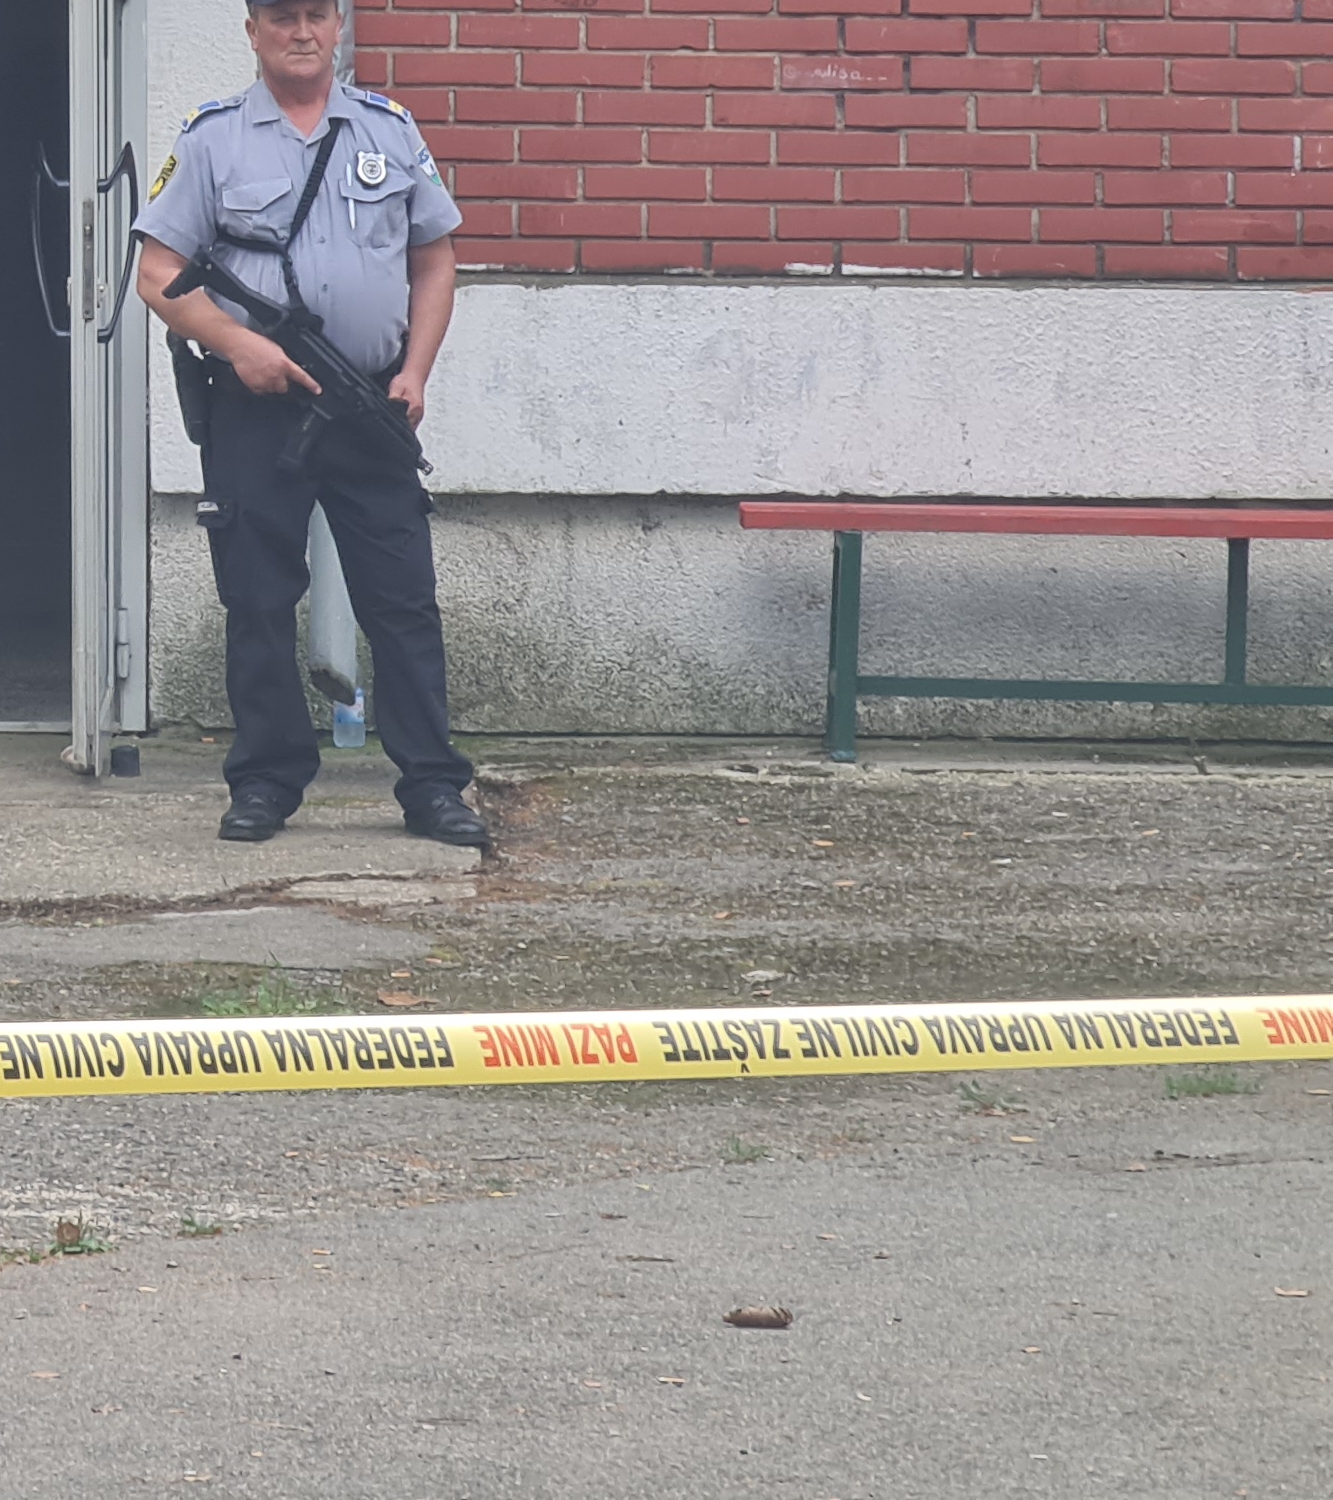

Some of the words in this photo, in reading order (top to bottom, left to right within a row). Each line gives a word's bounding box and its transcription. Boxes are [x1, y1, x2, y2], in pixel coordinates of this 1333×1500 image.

[267, 1026, 455, 1072] FEDERALNA
[473, 1025, 561, 1069] MINE
[562, 1023, 639, 1066] PAZI
[653, 1018, 791, 1074] ZAŠTITE
[790, 1016, 919, 1060] CIVILNE
[920, 1014, 1053, 1056] UPRAVA
[1048, 1008, 1240, 1051] FEDERALNA
[129, 1030, 263, 1077] UPRAVA
